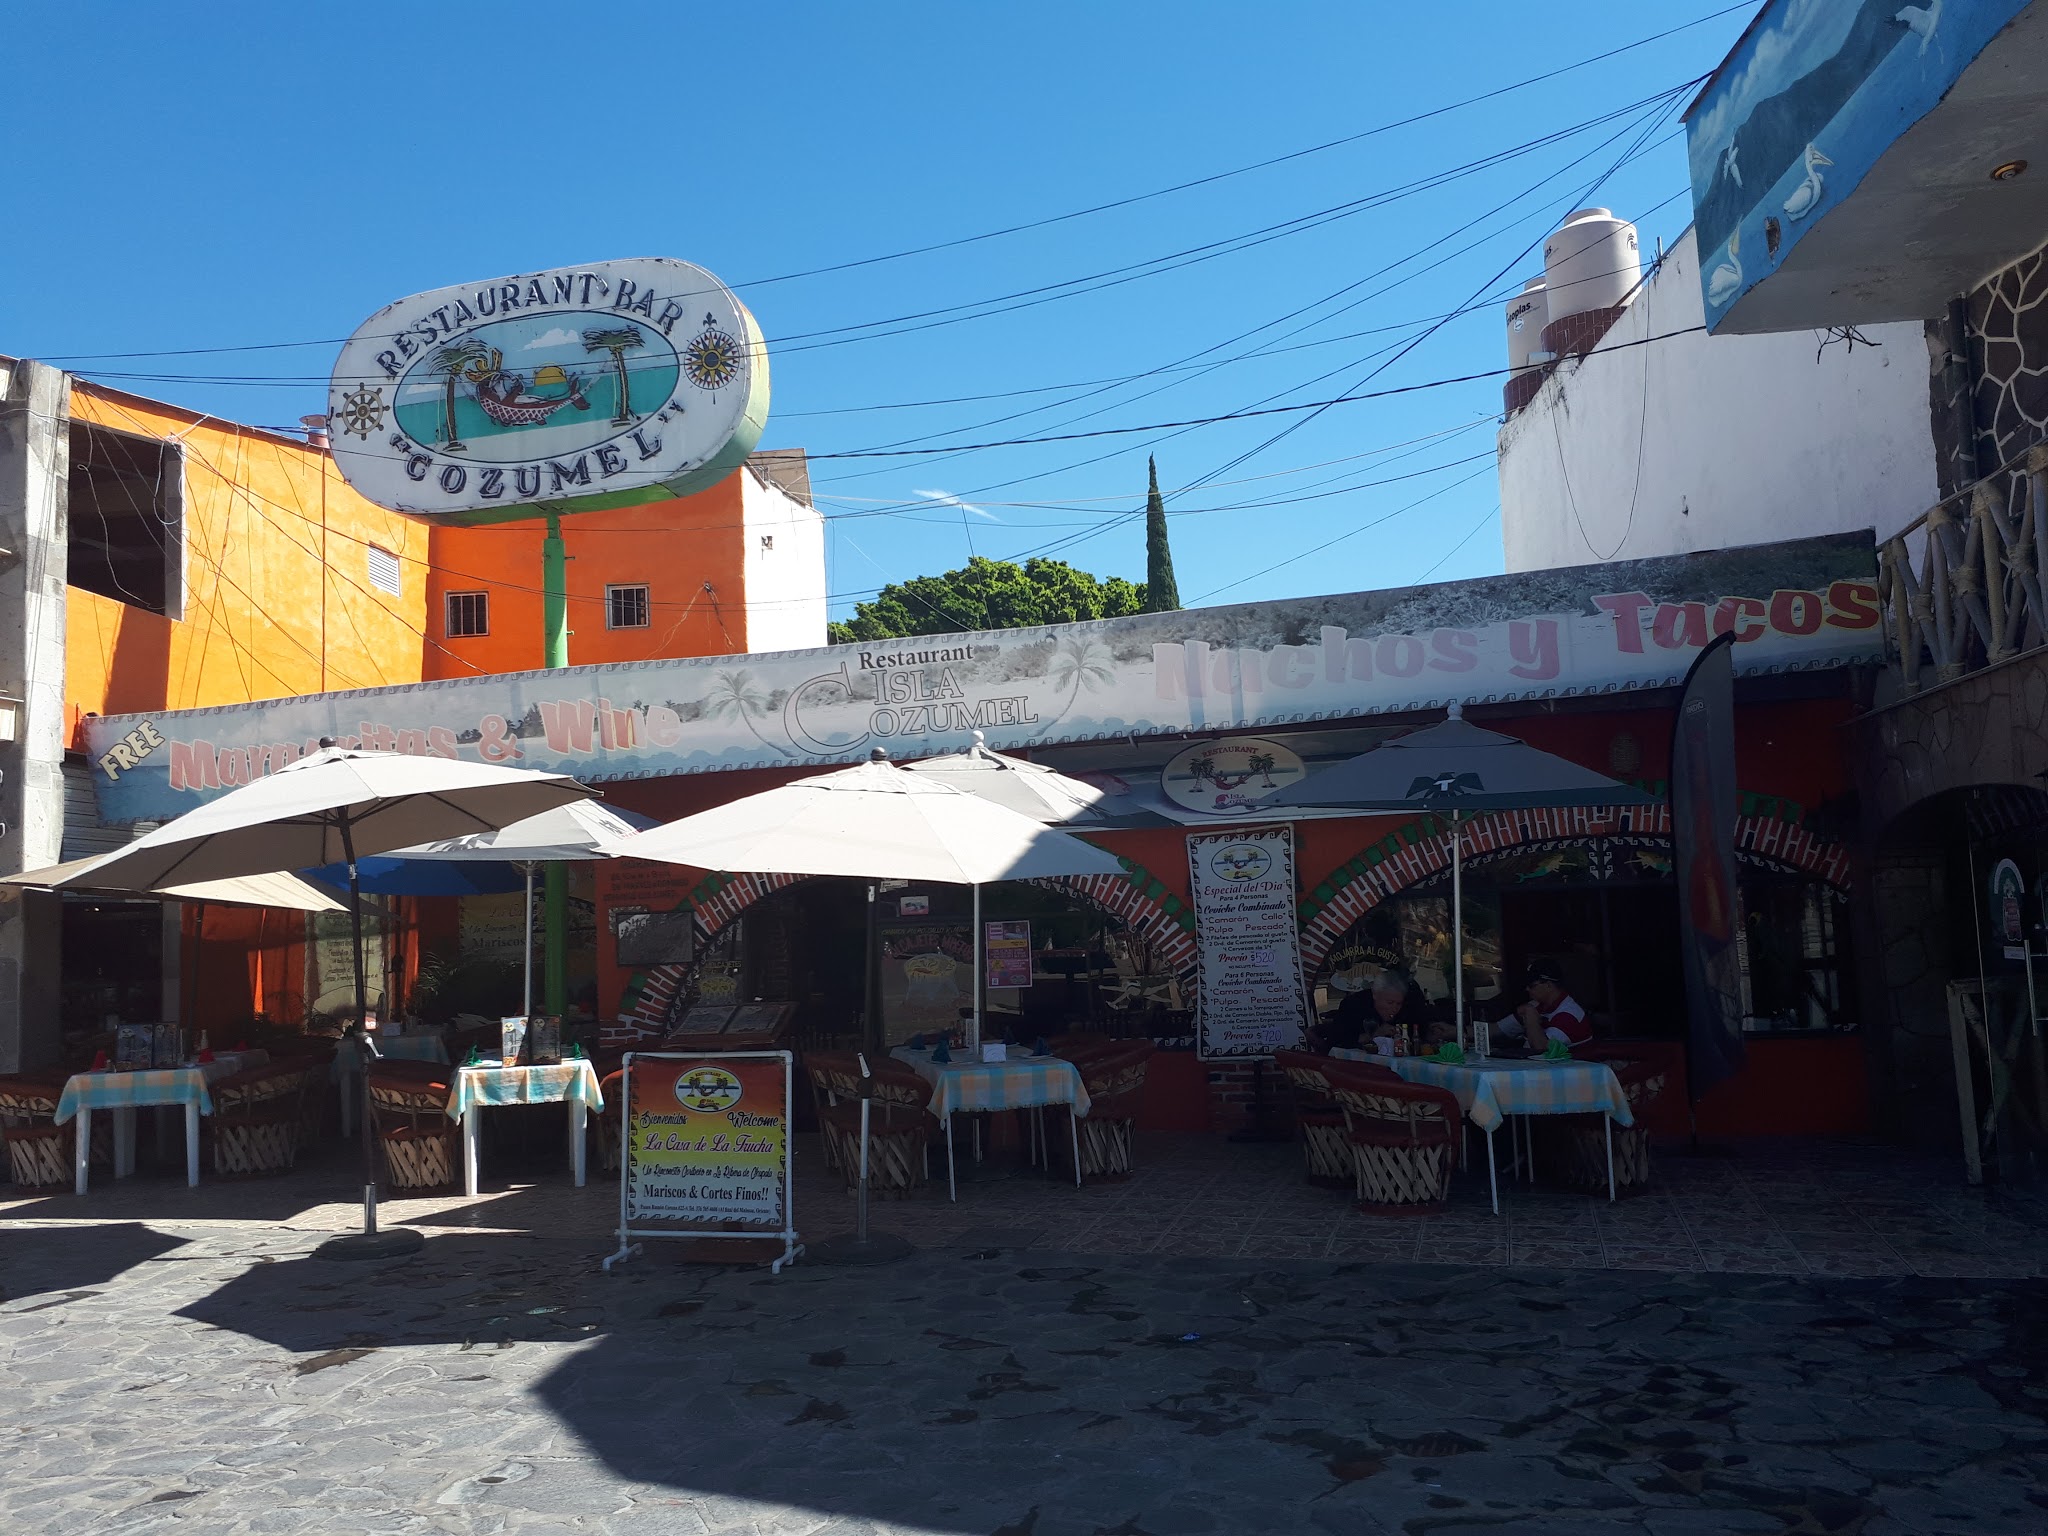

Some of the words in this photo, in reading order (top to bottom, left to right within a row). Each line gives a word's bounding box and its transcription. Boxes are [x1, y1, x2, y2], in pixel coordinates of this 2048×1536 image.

[375, 272, 598, 380] RESTAURANT
[614, 277, 684, 335] BAR
[1152, 624, 1479, 701] Nachos
[1508, 618, 1561, 680] y
[1591, 581, 1880, 654] Tacos
[858, 643, 975, 671] Restaurant
[870, 667, 965, 706] ISLA
[477, 713, 526, 762] &
[539, 698, 682, 757] Wine
[98, 720, 166, 781] FREE
[1201, 746, 1259, 758] RESTAURANT
[1204, 883, 1241, 898] Especial
[1243, 882, 1259, 893] del
[1203, 903, 1236, 914] Ceviche
[1237, 901, 1287, 912] Combinado
[472, 936, 526, 949] Mariscos
[1329, 945, 1365, 965] MOJARRA
[1366, 946, 1376, 956] AL
[1377, 947, 1400, 965] GUSTO
[640, 1111, 688, 1129] Bienvenidos
[727, 1111, 779, 1128] Welcome
[643, 1132, 663, 1151] La
[665, 1132, 690, 1151] Casa
[694, 1136, 708, 1152] de
[710, 1133, 731, 1152] La
[731, 1133, 774, 1153] Trucha
[742, 1168, 750, 1177] de
[643, 1184, 687, 1199] Mariscos
[689, 1185, 698, 1199] &
[701, 1185, 733, 1200] Cortes
[735, 1186, 769, 1201] Finos!!
